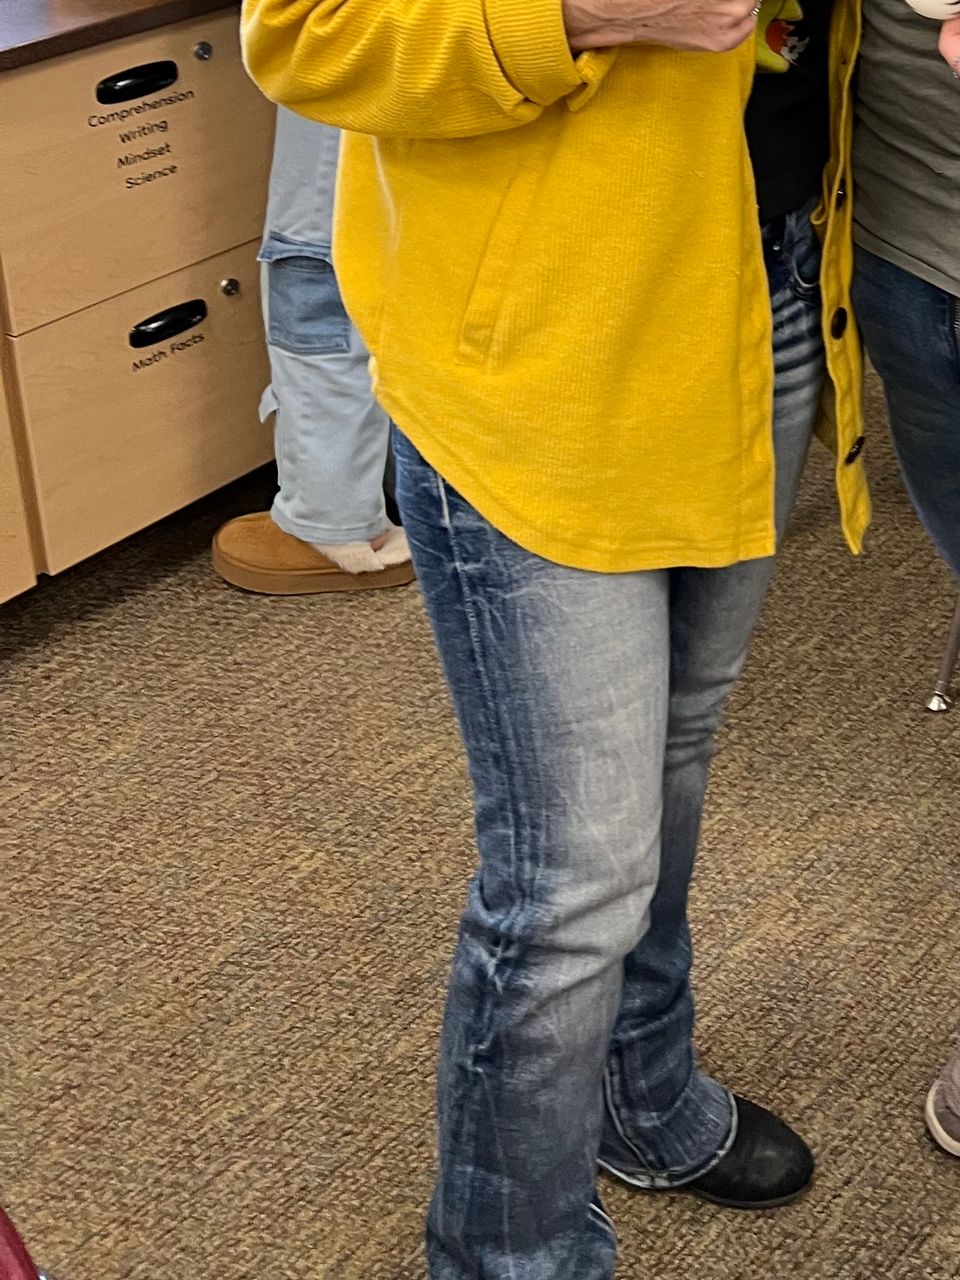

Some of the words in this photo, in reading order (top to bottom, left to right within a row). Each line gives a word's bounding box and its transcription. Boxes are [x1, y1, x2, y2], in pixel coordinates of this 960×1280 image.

[88, 90, 195, 128] Comprehension
[119, 120, 169, 144] Writing
[117, 142, 172, 168] Mindset
[125, 165, 178, 189] Science
[132, 350, 168, 373] Math
[170, 333, 205, 354] Facts
